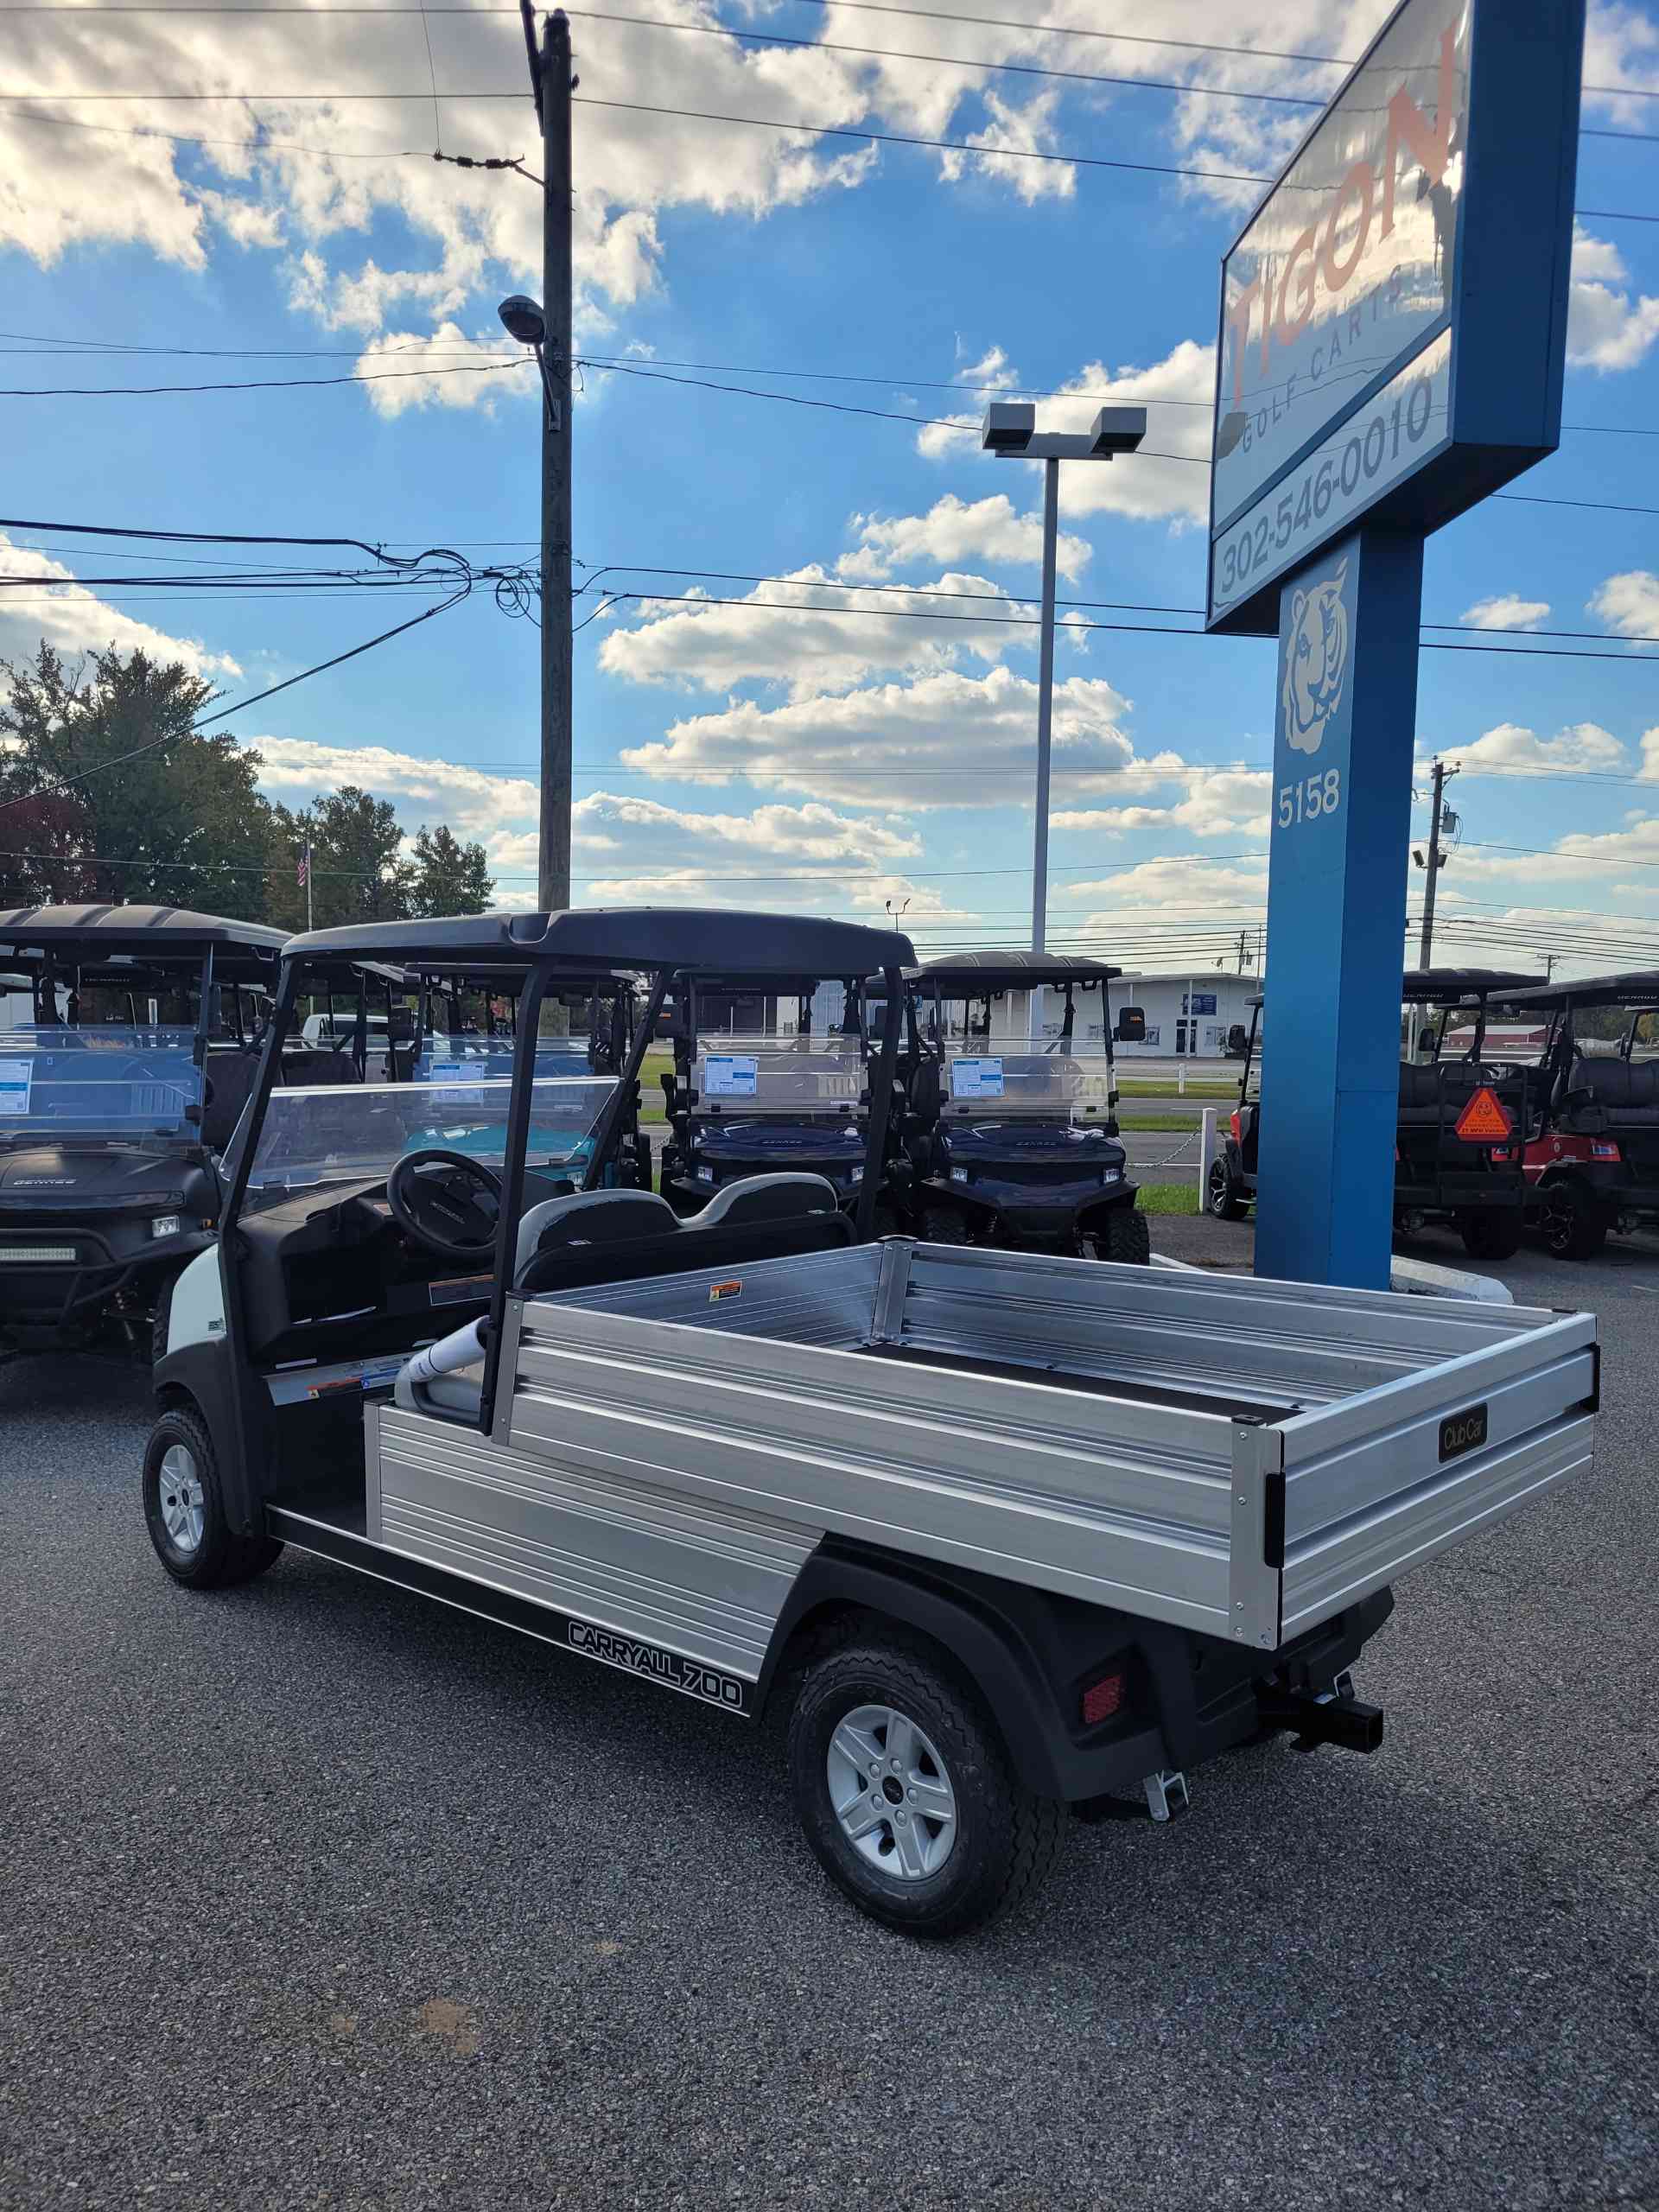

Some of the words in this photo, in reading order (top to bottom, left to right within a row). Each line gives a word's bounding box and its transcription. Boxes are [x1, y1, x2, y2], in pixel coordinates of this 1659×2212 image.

[1228, 17, 1457, 412] TIGON
[1243, 373, 1297, 453] GOLF
[1311, 264, 1402, 381] CARTS
[1221, 377, 1433, 594] 302-546-0010
[1278, 768, 1340, 829] 5158
[1444, 1423, 1466, 1451] Club
[1466, 1418, 1484, 1441] Car
[568, 1620, 681, 1687] CARRYALL
[681, 1660, 743, 1708] 700
